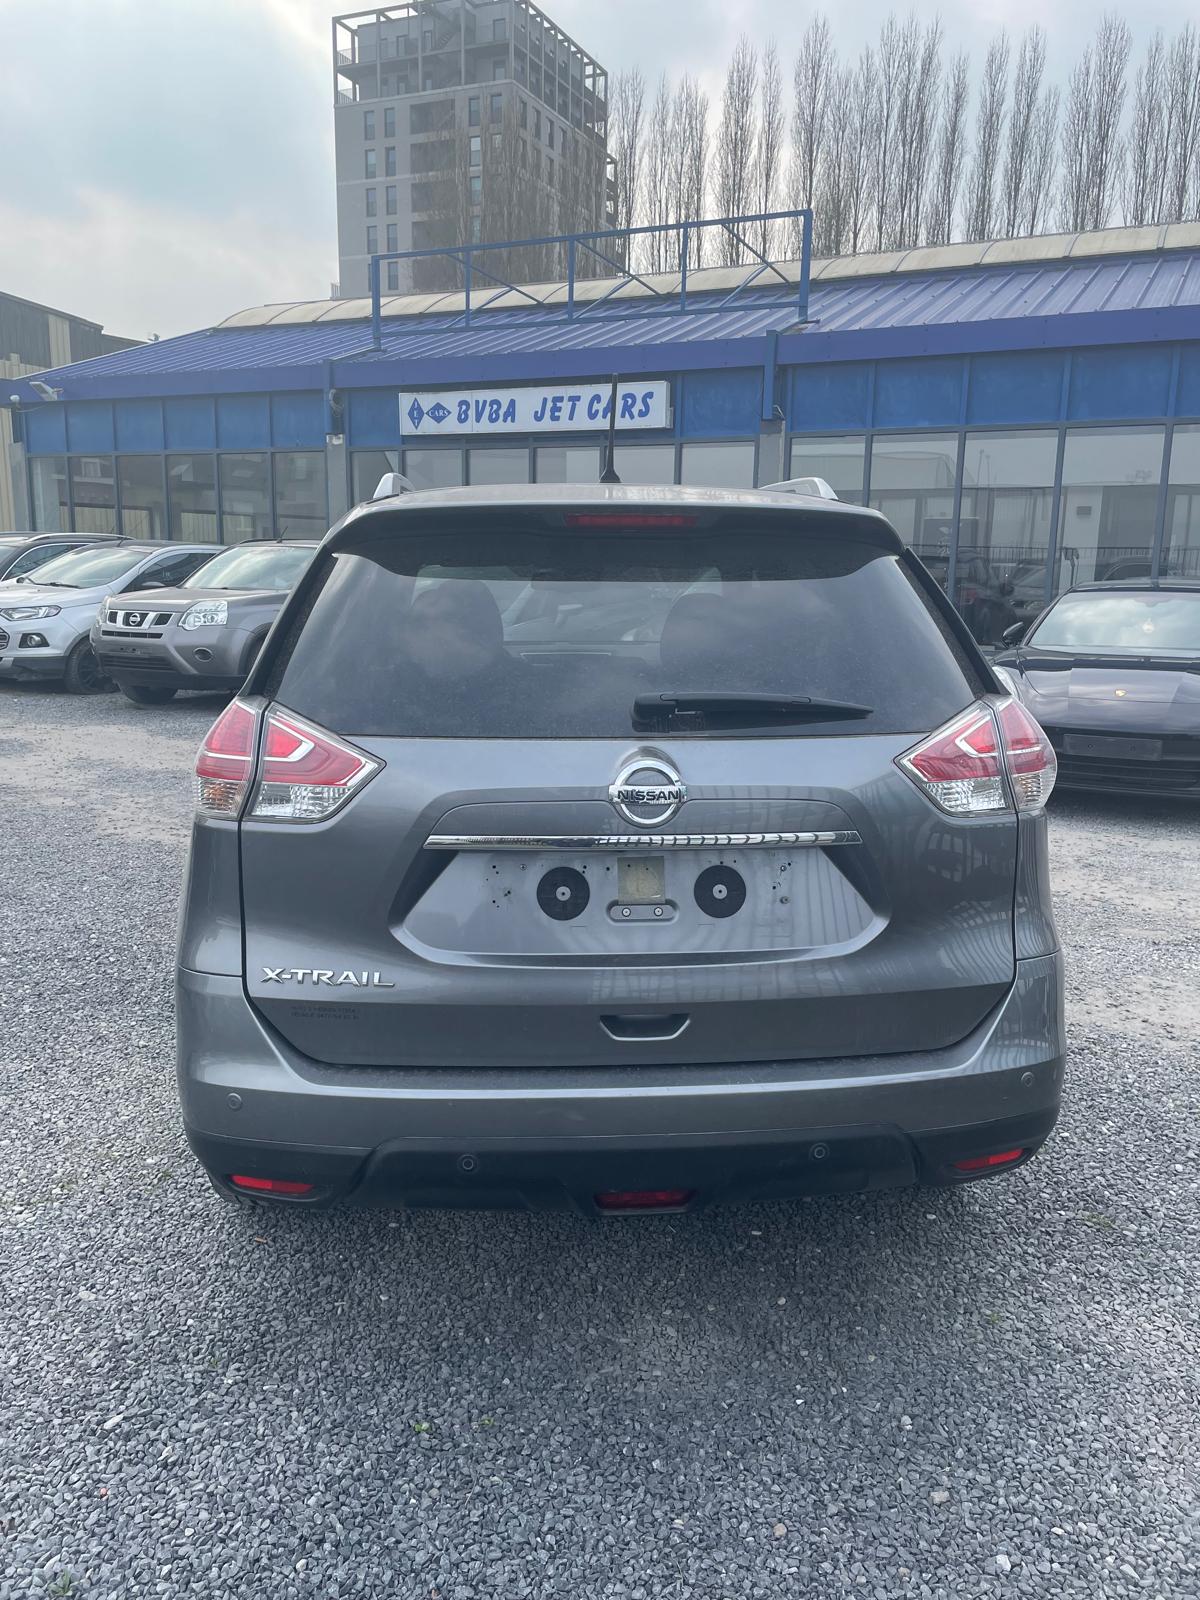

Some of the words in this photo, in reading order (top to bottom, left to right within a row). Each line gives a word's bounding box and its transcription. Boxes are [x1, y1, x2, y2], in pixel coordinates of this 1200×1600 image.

[428, 409, 449, 417] CARS
[457, 399, 516, 424] BVBA
[534, 395, 581, 421] JET
[617, 789, 679, 801] NISSAN
[260, 967, 396, 987] X-TRAIL
